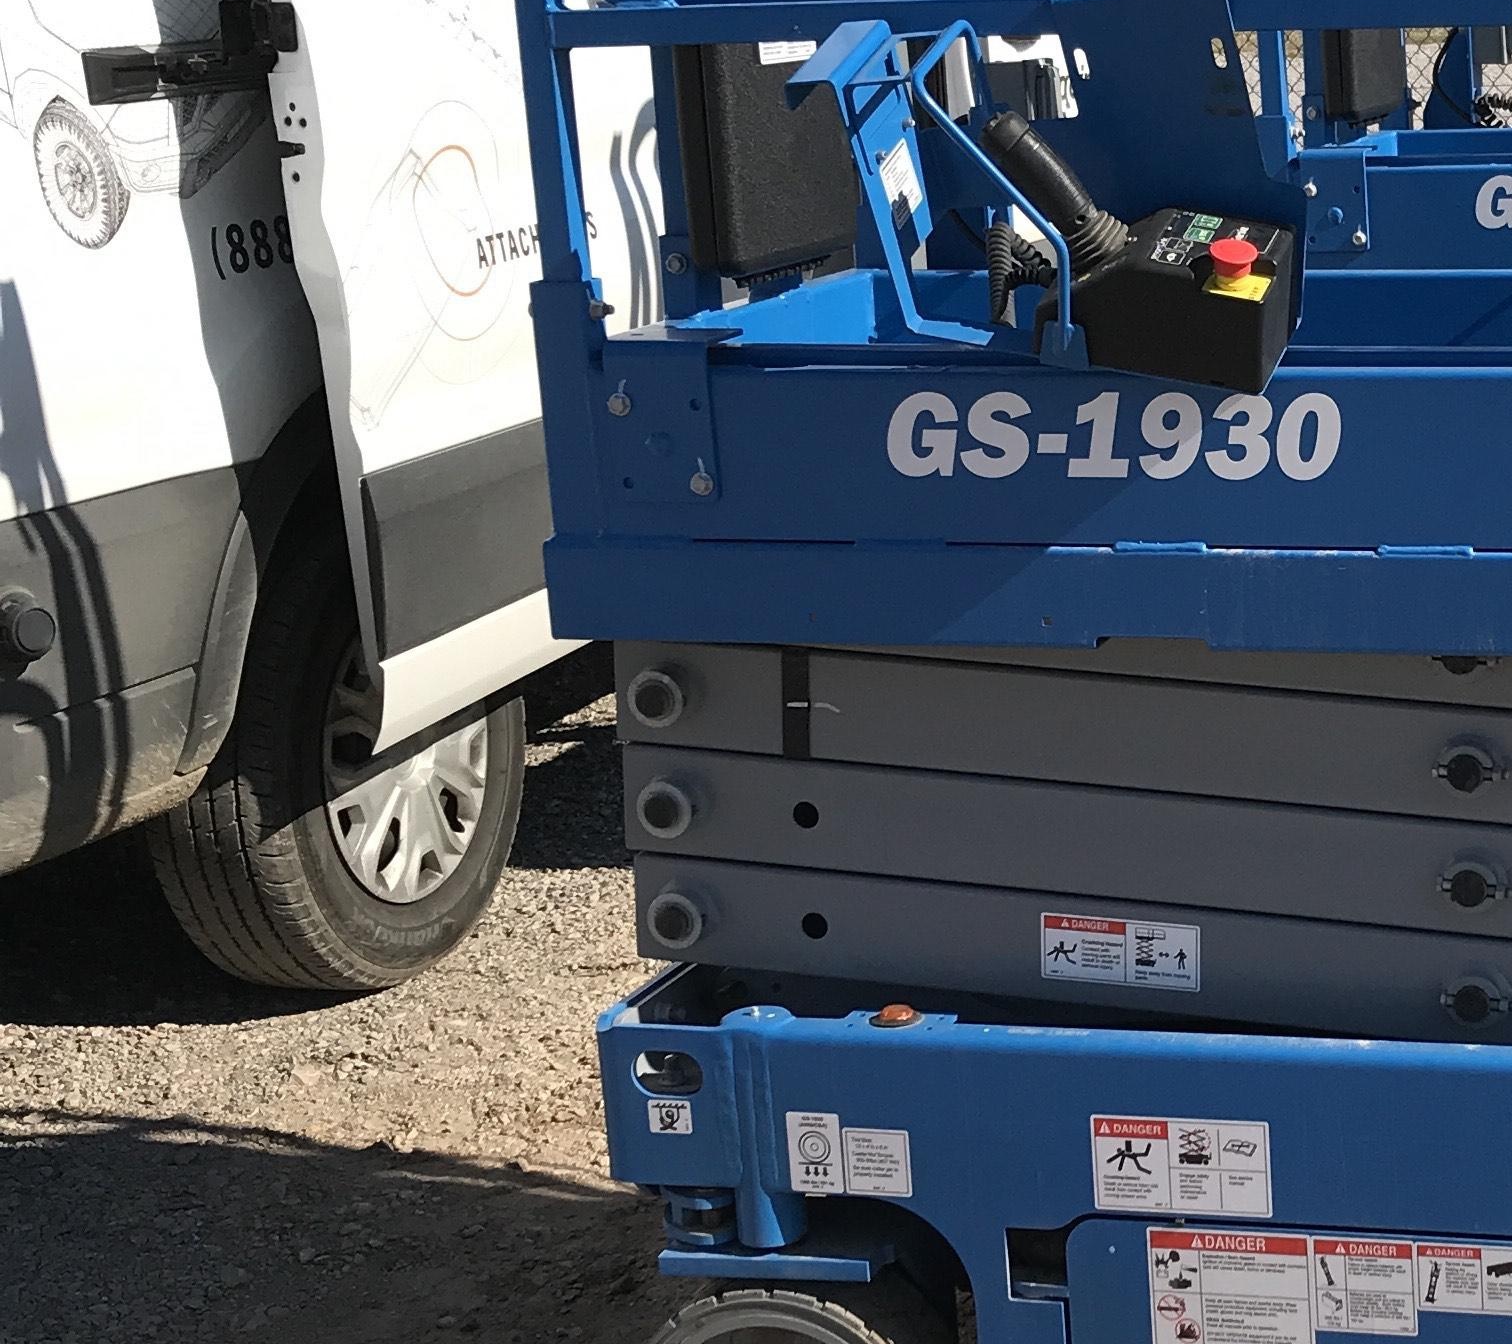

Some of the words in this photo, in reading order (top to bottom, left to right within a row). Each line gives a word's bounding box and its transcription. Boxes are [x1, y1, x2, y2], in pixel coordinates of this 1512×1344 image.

[476, 211, 598, 268] ATTACHS
[886, 392, 1342, 480] GS-1930
[1071, 920, 1108, 930] DANGER
[1113, 1123, 1162, 1135] DANGER
[1205, 1236, 1266, 1251] DANGER
[1349, 1243, 1397, 1257] DANGER
[1434, 1247, 1474, 1257] DANGER
